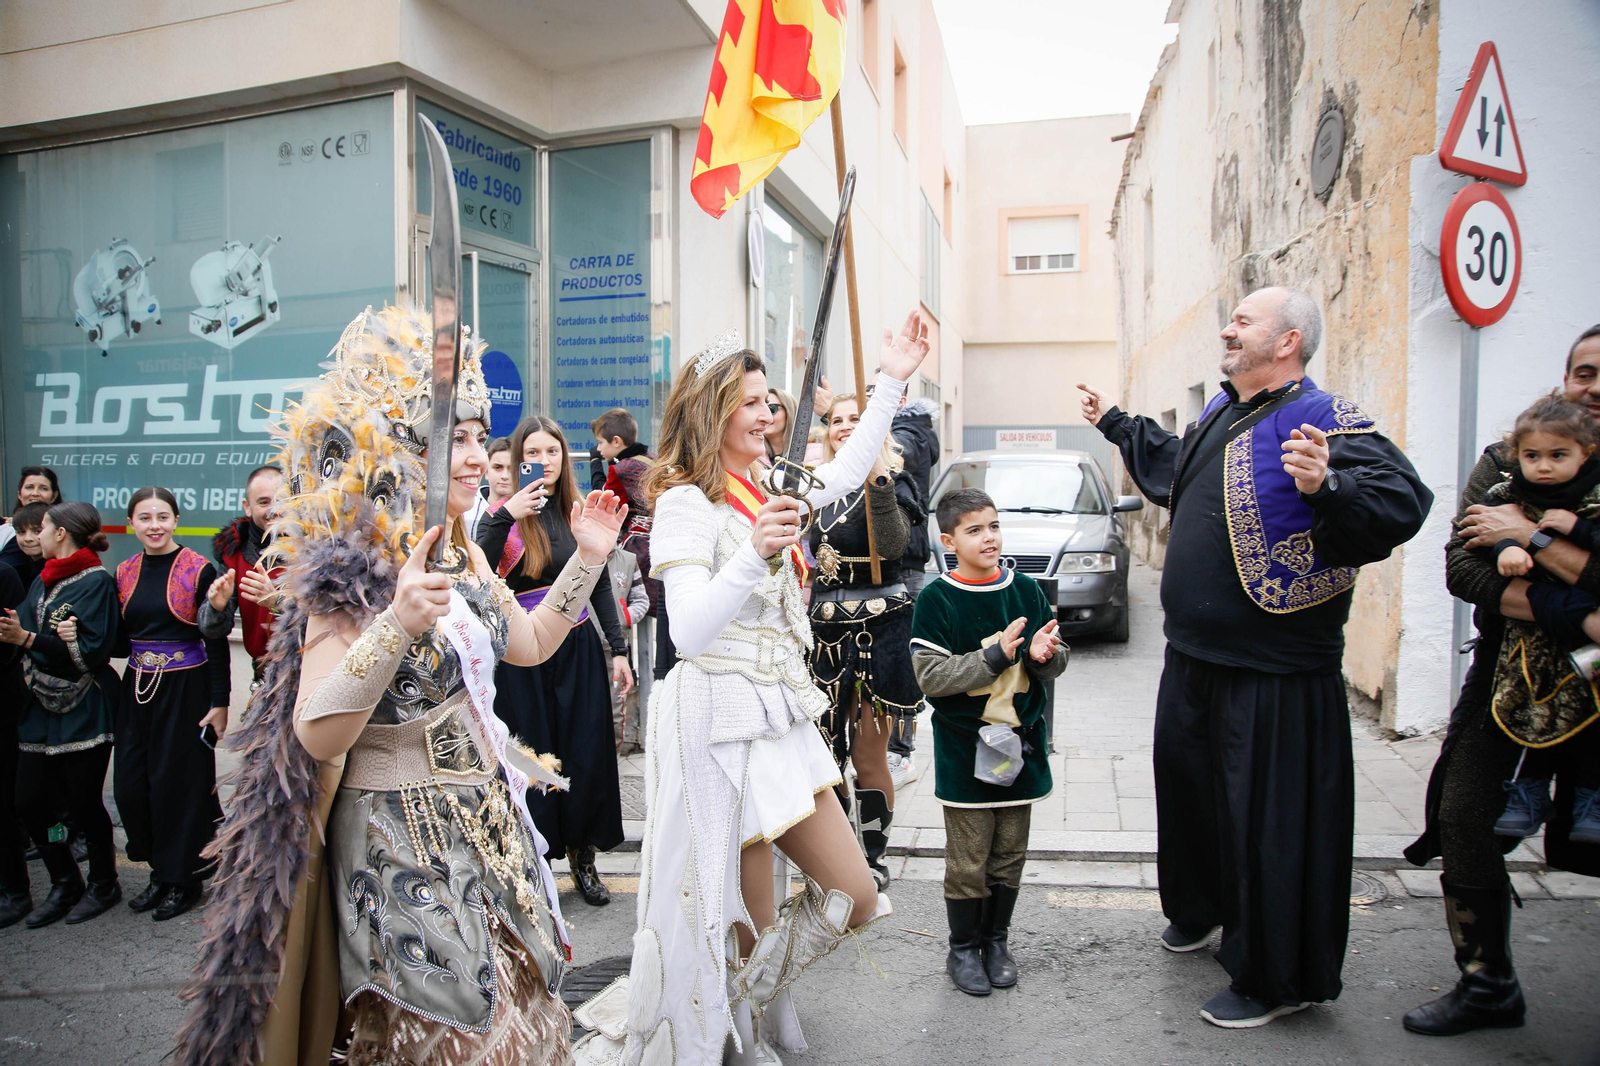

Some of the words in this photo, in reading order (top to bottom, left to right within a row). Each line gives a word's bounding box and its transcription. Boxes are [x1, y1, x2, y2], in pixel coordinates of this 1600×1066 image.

[322, 136, 345, 159] CE
[436, 120, 521, 173] Fabricando
[482, 175, 522, 206] 1960
[480, 205, 497, 229] CE
[569, 255, 612, 270] CARTA
[616, 253, 636, 267] DE
[1465, 225, 1507, 286] 30
[561, 273, 643, 291] PRODUCTOS
[557, 316, 597, 326] Cortadoras
[599, 314, 608, 324] de
[611, 312, 650, 324] embutidos
[557, 336, 597, 346] Cortadoras
[599, 333, 645, 344] automáticas
[557, 356, 589, 366] Cortadoras
[590, 355, 598, 365] de
[600, 356, 617, 365] carne
[618, 353, 649, 365] congelada
[557, 378, 583, 388] Cortadoras
[585, 377, 609, 387] verticales
[610, 376, 617, 387] de
[618, 378, 632, 386] carne
[633, 375, 649, 386] fresca
[35, 364, 322, 437] Bosto
[557, 398, 591, 408] Cortadoras
[593, 397, 623, 407] manuales
[624, 396, 650, 408] Vintage
[557, 420, 591, 430] Picadoras
[569, 442, 583, 450] rras
[585, 440, 594, 450] de
[1000, 432, 1017, 441] SALIDA
[1018, 432, 1024, 441] DE
[41, 453, 118, 466] SLICERS
[127, 453, 139, 465] &
[150, 453, 206, 465] FOOD
[215, 452, 278, 466] EQUIP
[93, 487, 197, 510] PROTS
[452, 620, 472, 651] Reina
[468, 654, 483, 686] Mora
